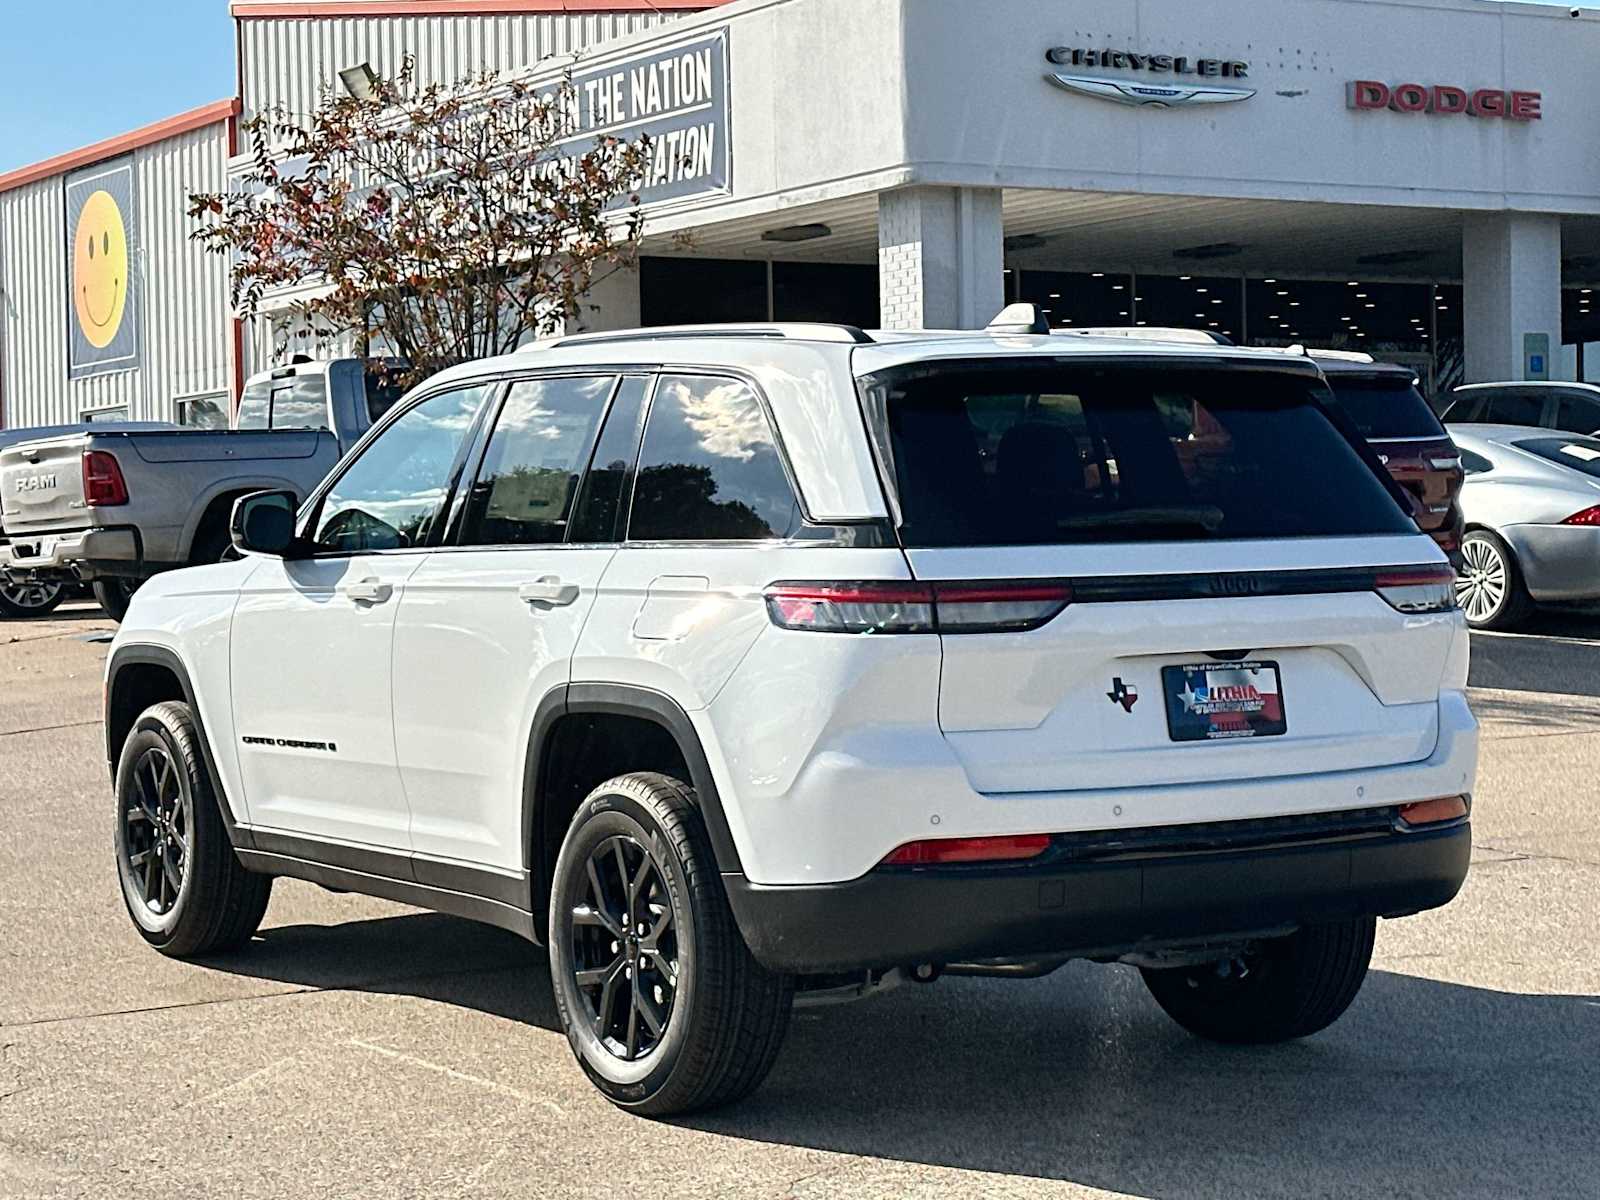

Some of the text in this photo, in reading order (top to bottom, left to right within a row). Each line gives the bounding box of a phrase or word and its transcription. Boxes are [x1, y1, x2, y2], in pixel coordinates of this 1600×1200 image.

[1046, 46, 1248, 78] CHRYSLER
[584, 72, 625, 128] THE
[630, 47, 712, 118] NATION
[1347, 80, 1541, 119] DODGE
[16, 473, 56, 492] RAM
[1209, 685, 1261, 702] LITHIA
